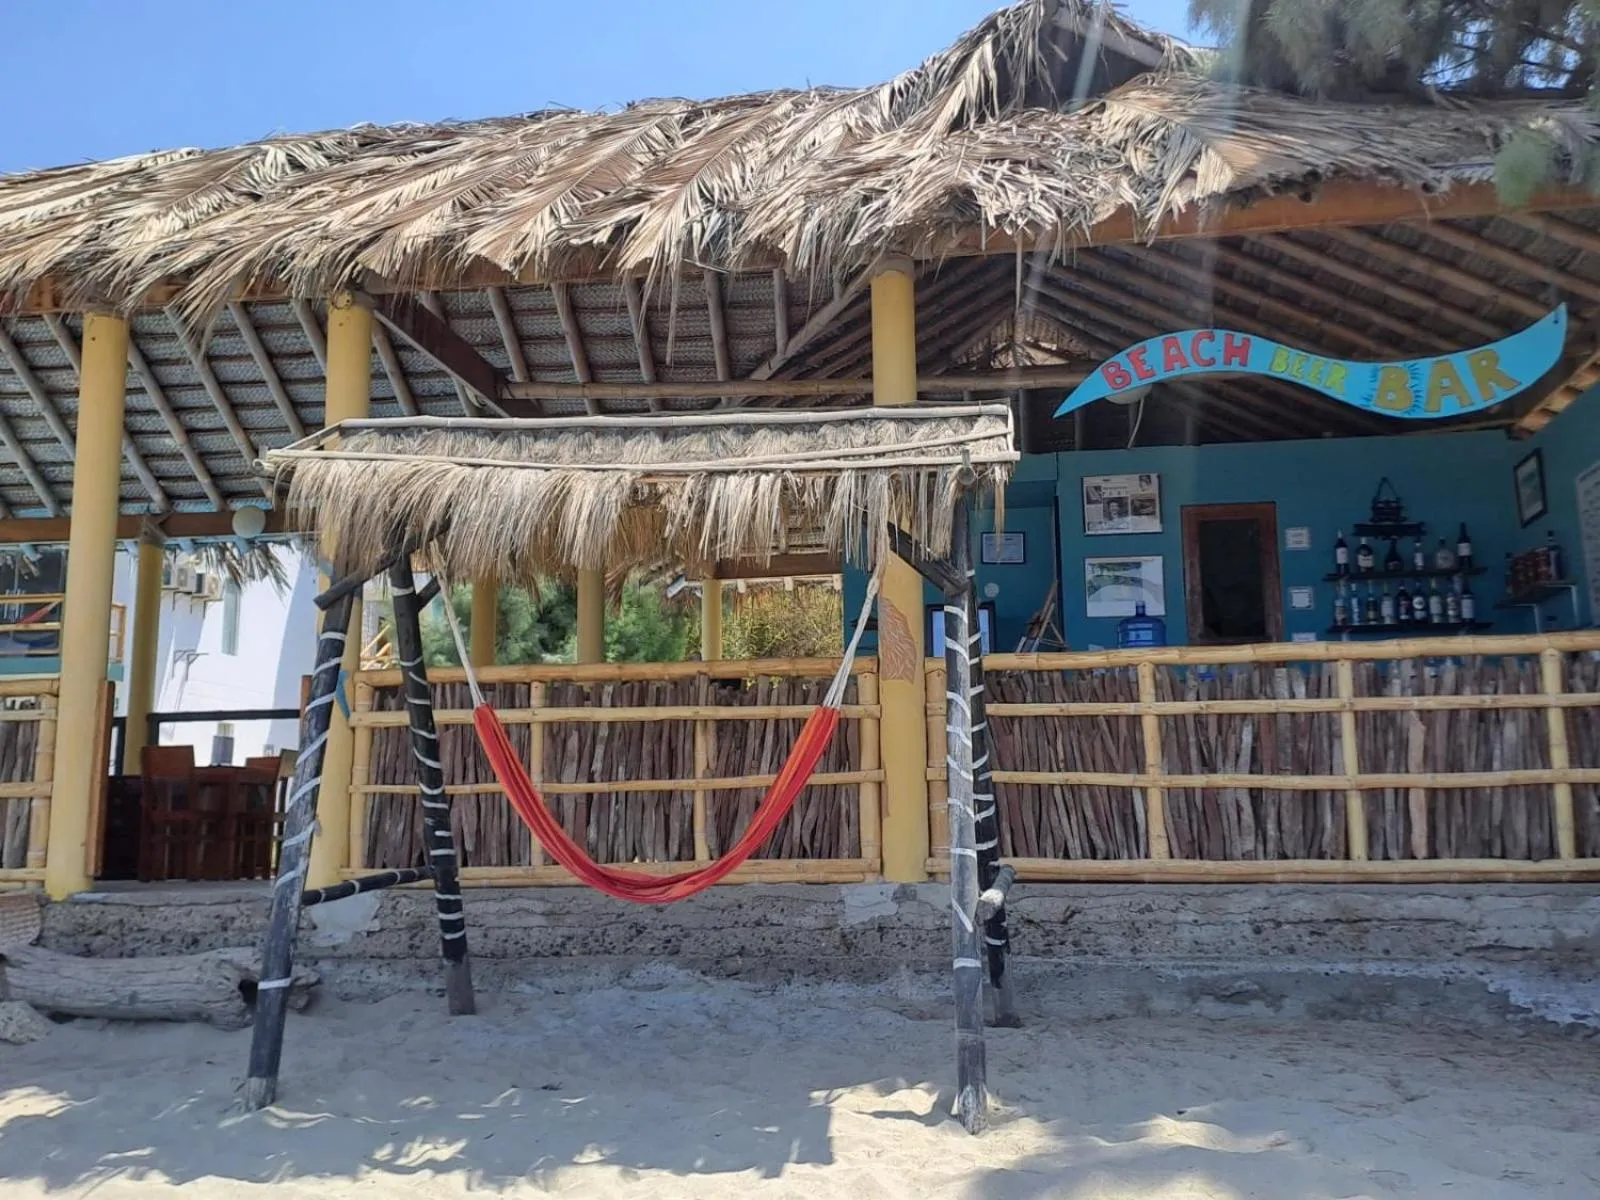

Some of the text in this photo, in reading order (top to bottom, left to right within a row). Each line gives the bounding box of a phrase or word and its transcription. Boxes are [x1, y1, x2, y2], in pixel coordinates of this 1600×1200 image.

[1101, 331, 1522, 413] BEACH BEER BAR
